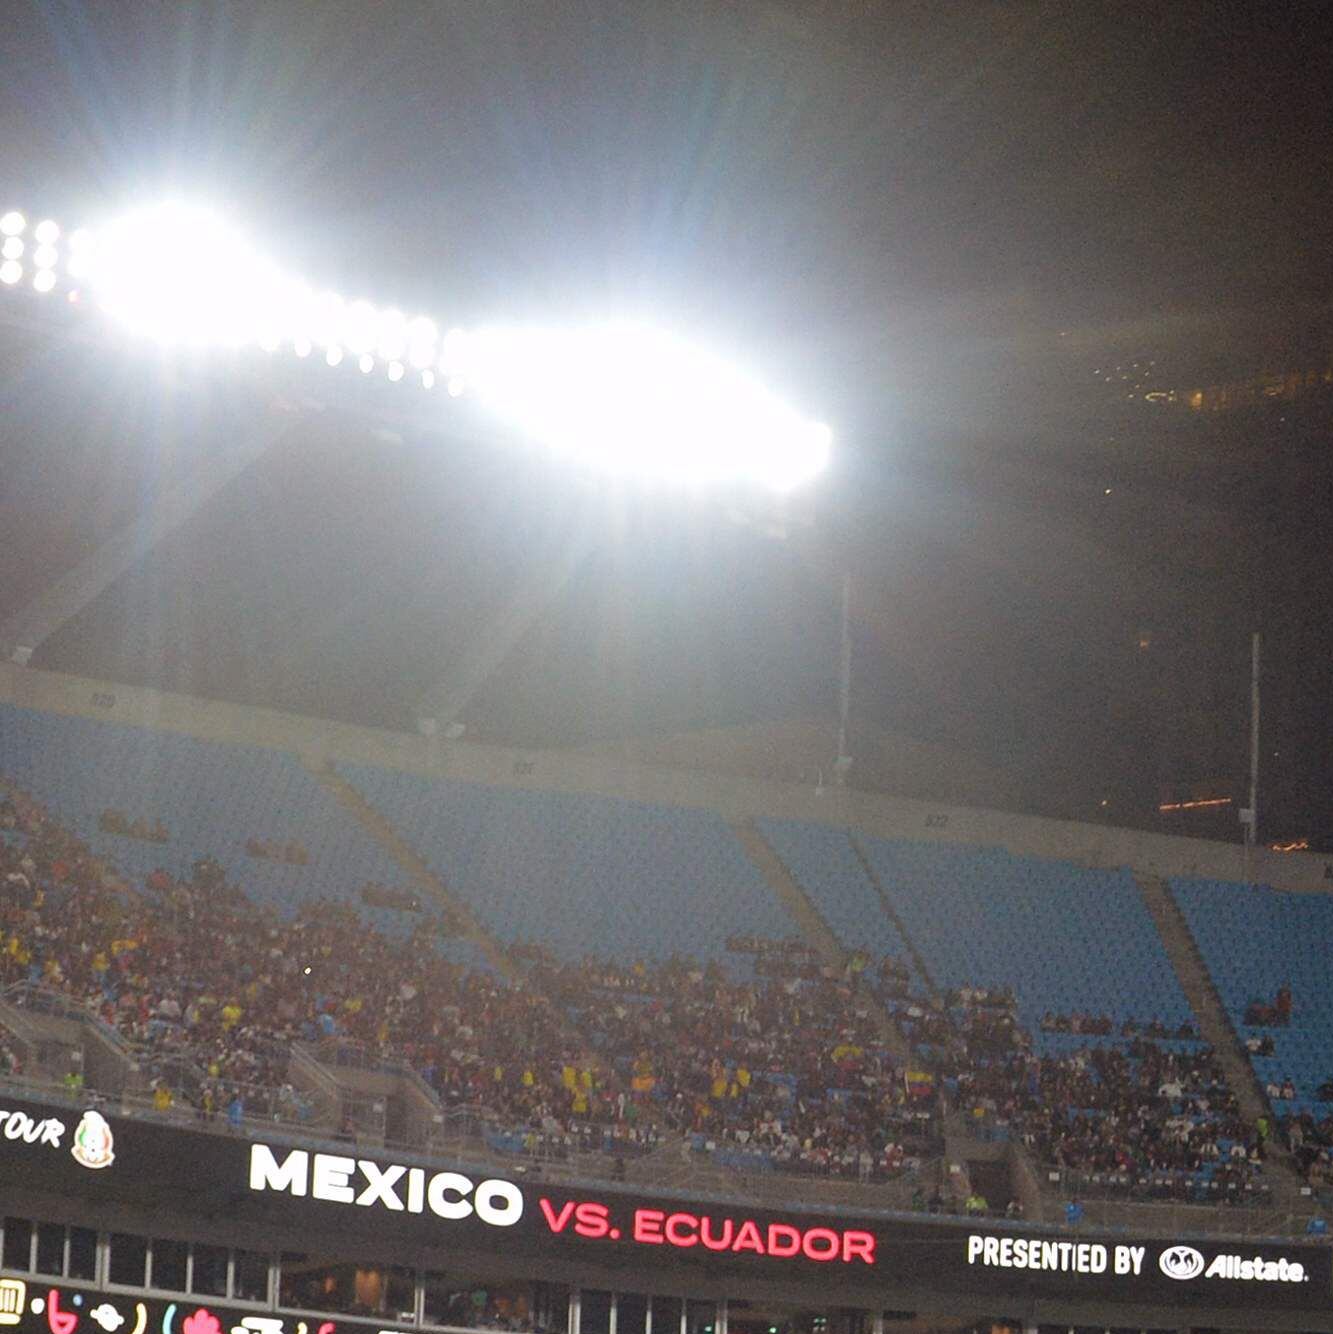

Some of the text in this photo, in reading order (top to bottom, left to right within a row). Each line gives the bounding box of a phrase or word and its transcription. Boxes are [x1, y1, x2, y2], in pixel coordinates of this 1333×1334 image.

[249, 1143, 875, 1264] MEXICO VS. ECUADOR
[1114, 1245, 1145, 1275] BY
